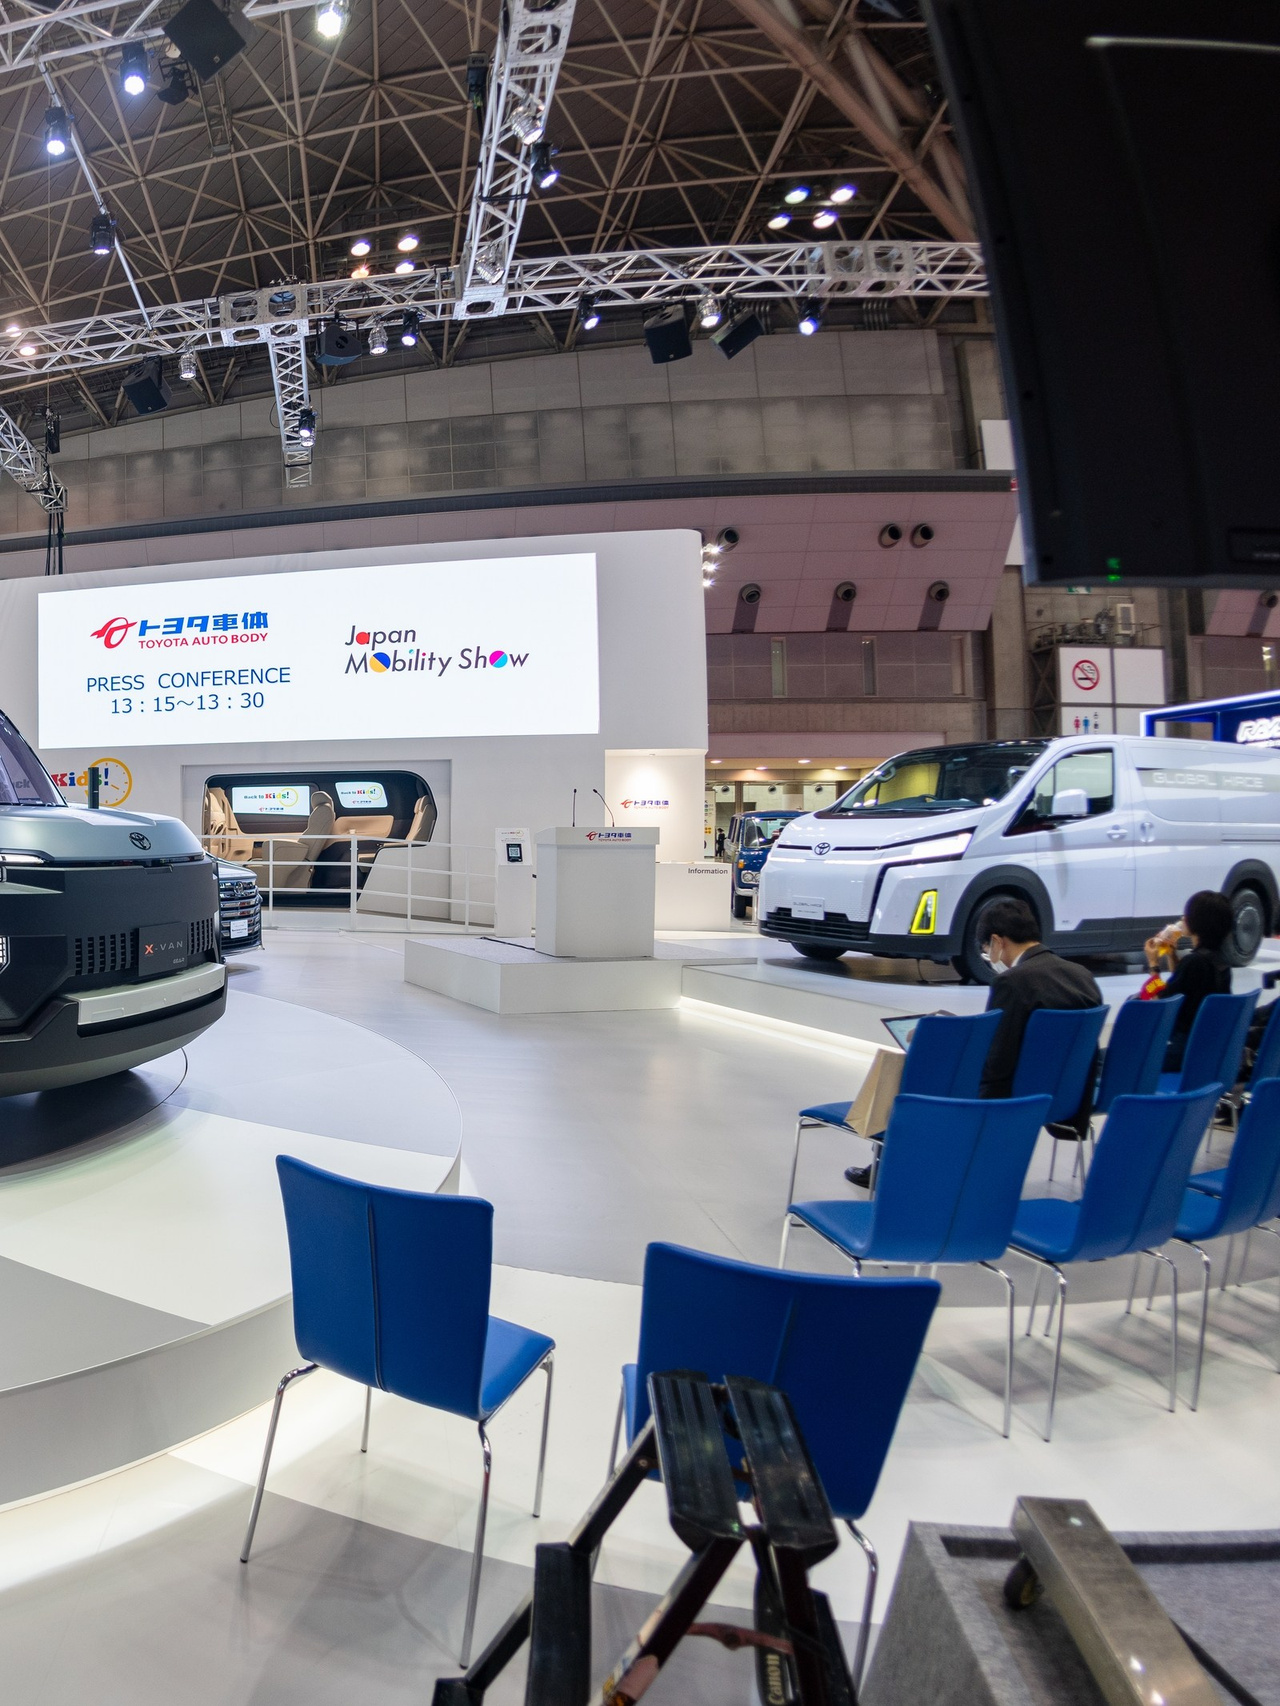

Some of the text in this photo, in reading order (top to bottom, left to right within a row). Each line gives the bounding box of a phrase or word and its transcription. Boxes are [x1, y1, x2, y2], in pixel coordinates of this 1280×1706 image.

[138, 611, 269, 637] トヨタ車体
[138, 632, 269, 649] TOYOTA AUTO BODY
[344, 625, 417, 651] Japan
[344, 646, 530, 677] Mobility Show
[87, 667, 291, 693] PRESS CONFERENCE
[265, 791, 290, 799] Kids!
[144, 940, 184, 955] X-VAN
